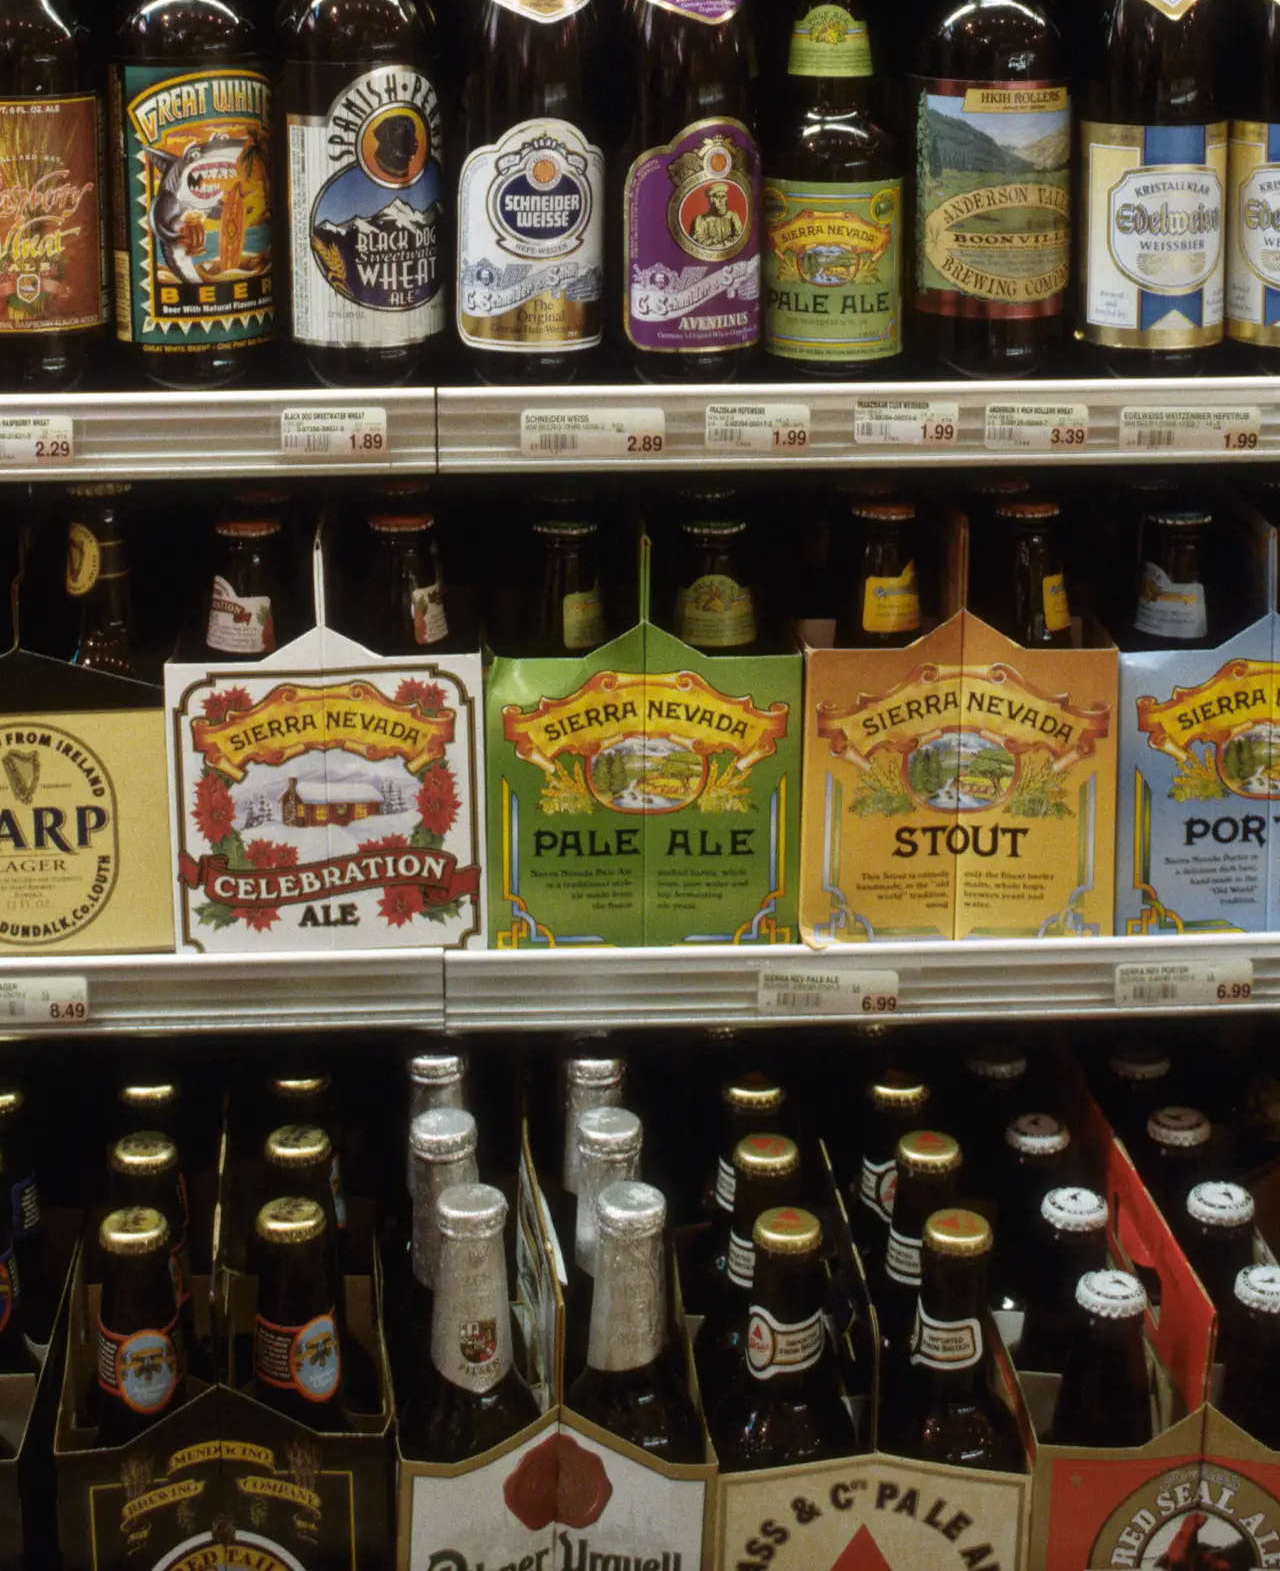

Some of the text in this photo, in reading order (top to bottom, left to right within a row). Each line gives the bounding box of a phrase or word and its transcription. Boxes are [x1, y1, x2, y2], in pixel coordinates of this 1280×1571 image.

[505, 194, 581, 212] SCHNEIDER
[516, 211, 570, 228] WEISSE
[355, 229, 437, 253] BLACK DOG
[356, 258, 437, 287] WHEAT
[768, 292, 891, 315] PALE ALE
[679, 312, 749, 330] AVENTINUS
[525, 415, 590, 424] SCHNEIDER WEISS
[1224, 432, 1258, 449] 1.99
[544, 699, 749, 741] SIERRA NEVADA
[862, 691, 1073, 742] SIERRA NEVADA
[1176, 689, 1267, 731] SIERRA
[229, 708, 421, 752] SIERRA NEVADA
[533, 829, 756, 858] PALE ALE
[891, 825, 1029, 858] STOUT
[214, 855, 446, 902] CELEBRATION
[298, 905, 361, 928] ALE
[50, 1001, 86, 1020] 8.49
